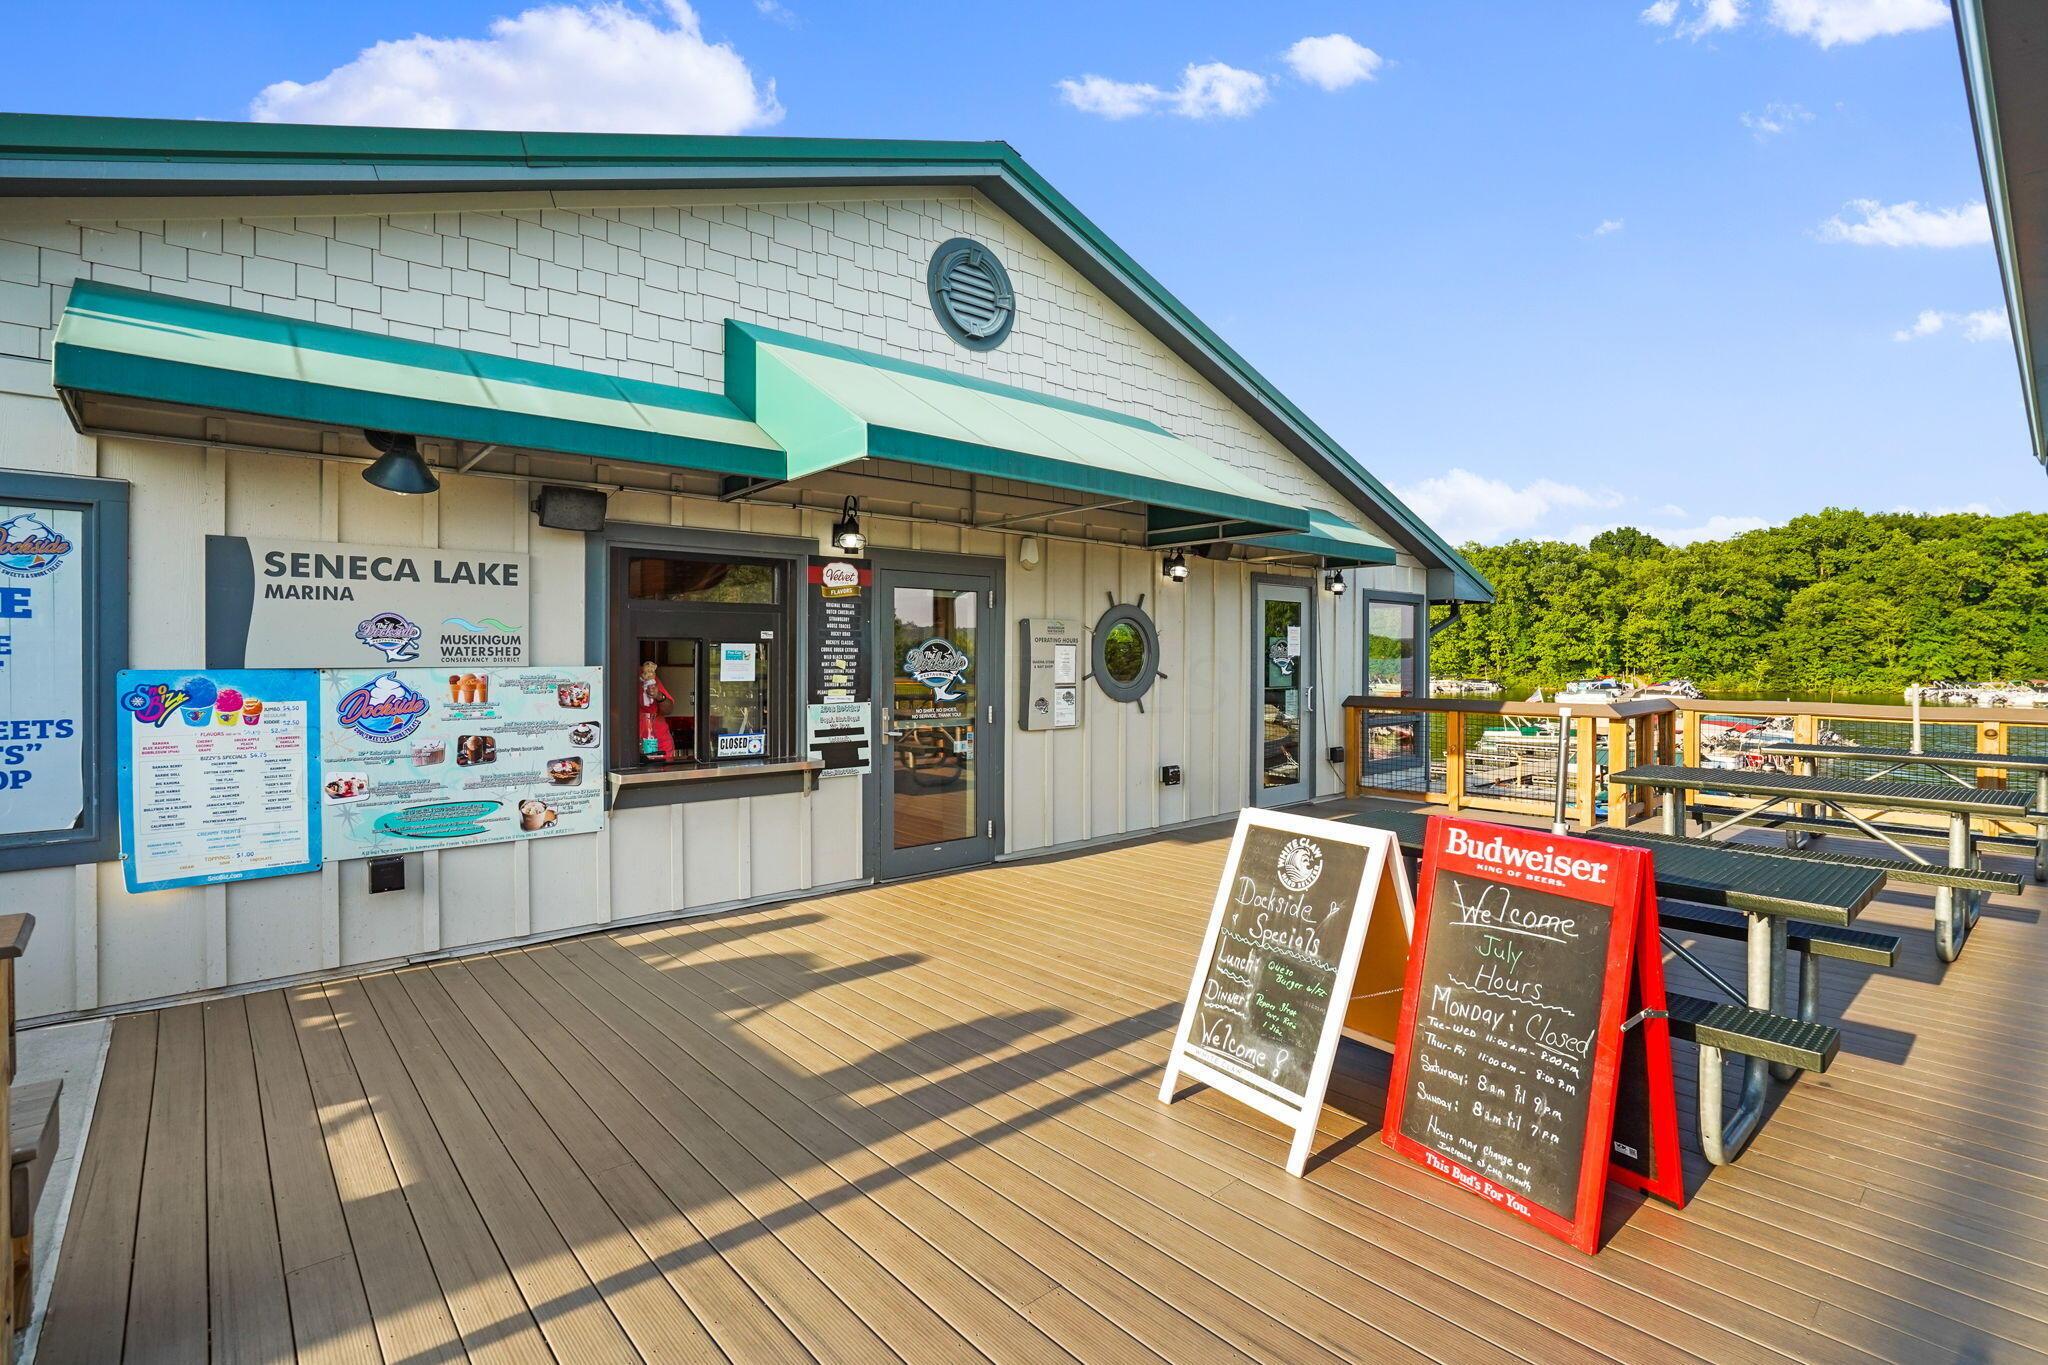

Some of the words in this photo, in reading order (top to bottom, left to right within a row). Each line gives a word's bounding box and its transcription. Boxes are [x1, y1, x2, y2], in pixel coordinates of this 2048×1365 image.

[264, 550, 420, 583] SENECA
[434, 560, 519, 587] LAKE
[825, 568, 856, 582] Velvet
[264, 584, 355, 601] MARINA
[440, 634, 521, 645] MUSKINGUM
[441, 646, 521, 657] WATERSHED
[1034, 636, 1062, 644] OPERATING
[339, 688, 425, 724] Dockside
[720, 737, 748, 750] CLOSED
[1277, 838, 1299, 868] WHITE
[1299, 837, 1323, 858] CLAW
[1281, 872, 1296, 888] HARD
[1297, 864, 1321, 889] SELTZER
[1476, 863, 1504, 875] KING
[1507, 869, 1522, 878] OF
[1235, 876, 1317, 923] Dockside
[1453, 879, 1579, 938] Welcome
[1248, 913, 1320, 957] Specials
[1475, 934, 1524, 975] July
[1275, 973, 1303, 991] Burger
[1474, 964, 1544, 1001] Hours
[1200, 1012, 1267, 1068] Welcome
[1525, 1013, 1596, 1059] Closed
[1426, 1114, 1454, 1141] Hours
[1425, 1151, 1450, 1174] This
[1451, 1165, 1482, 1191] Bud's
[1483, 1181, 1504, 1202] For
